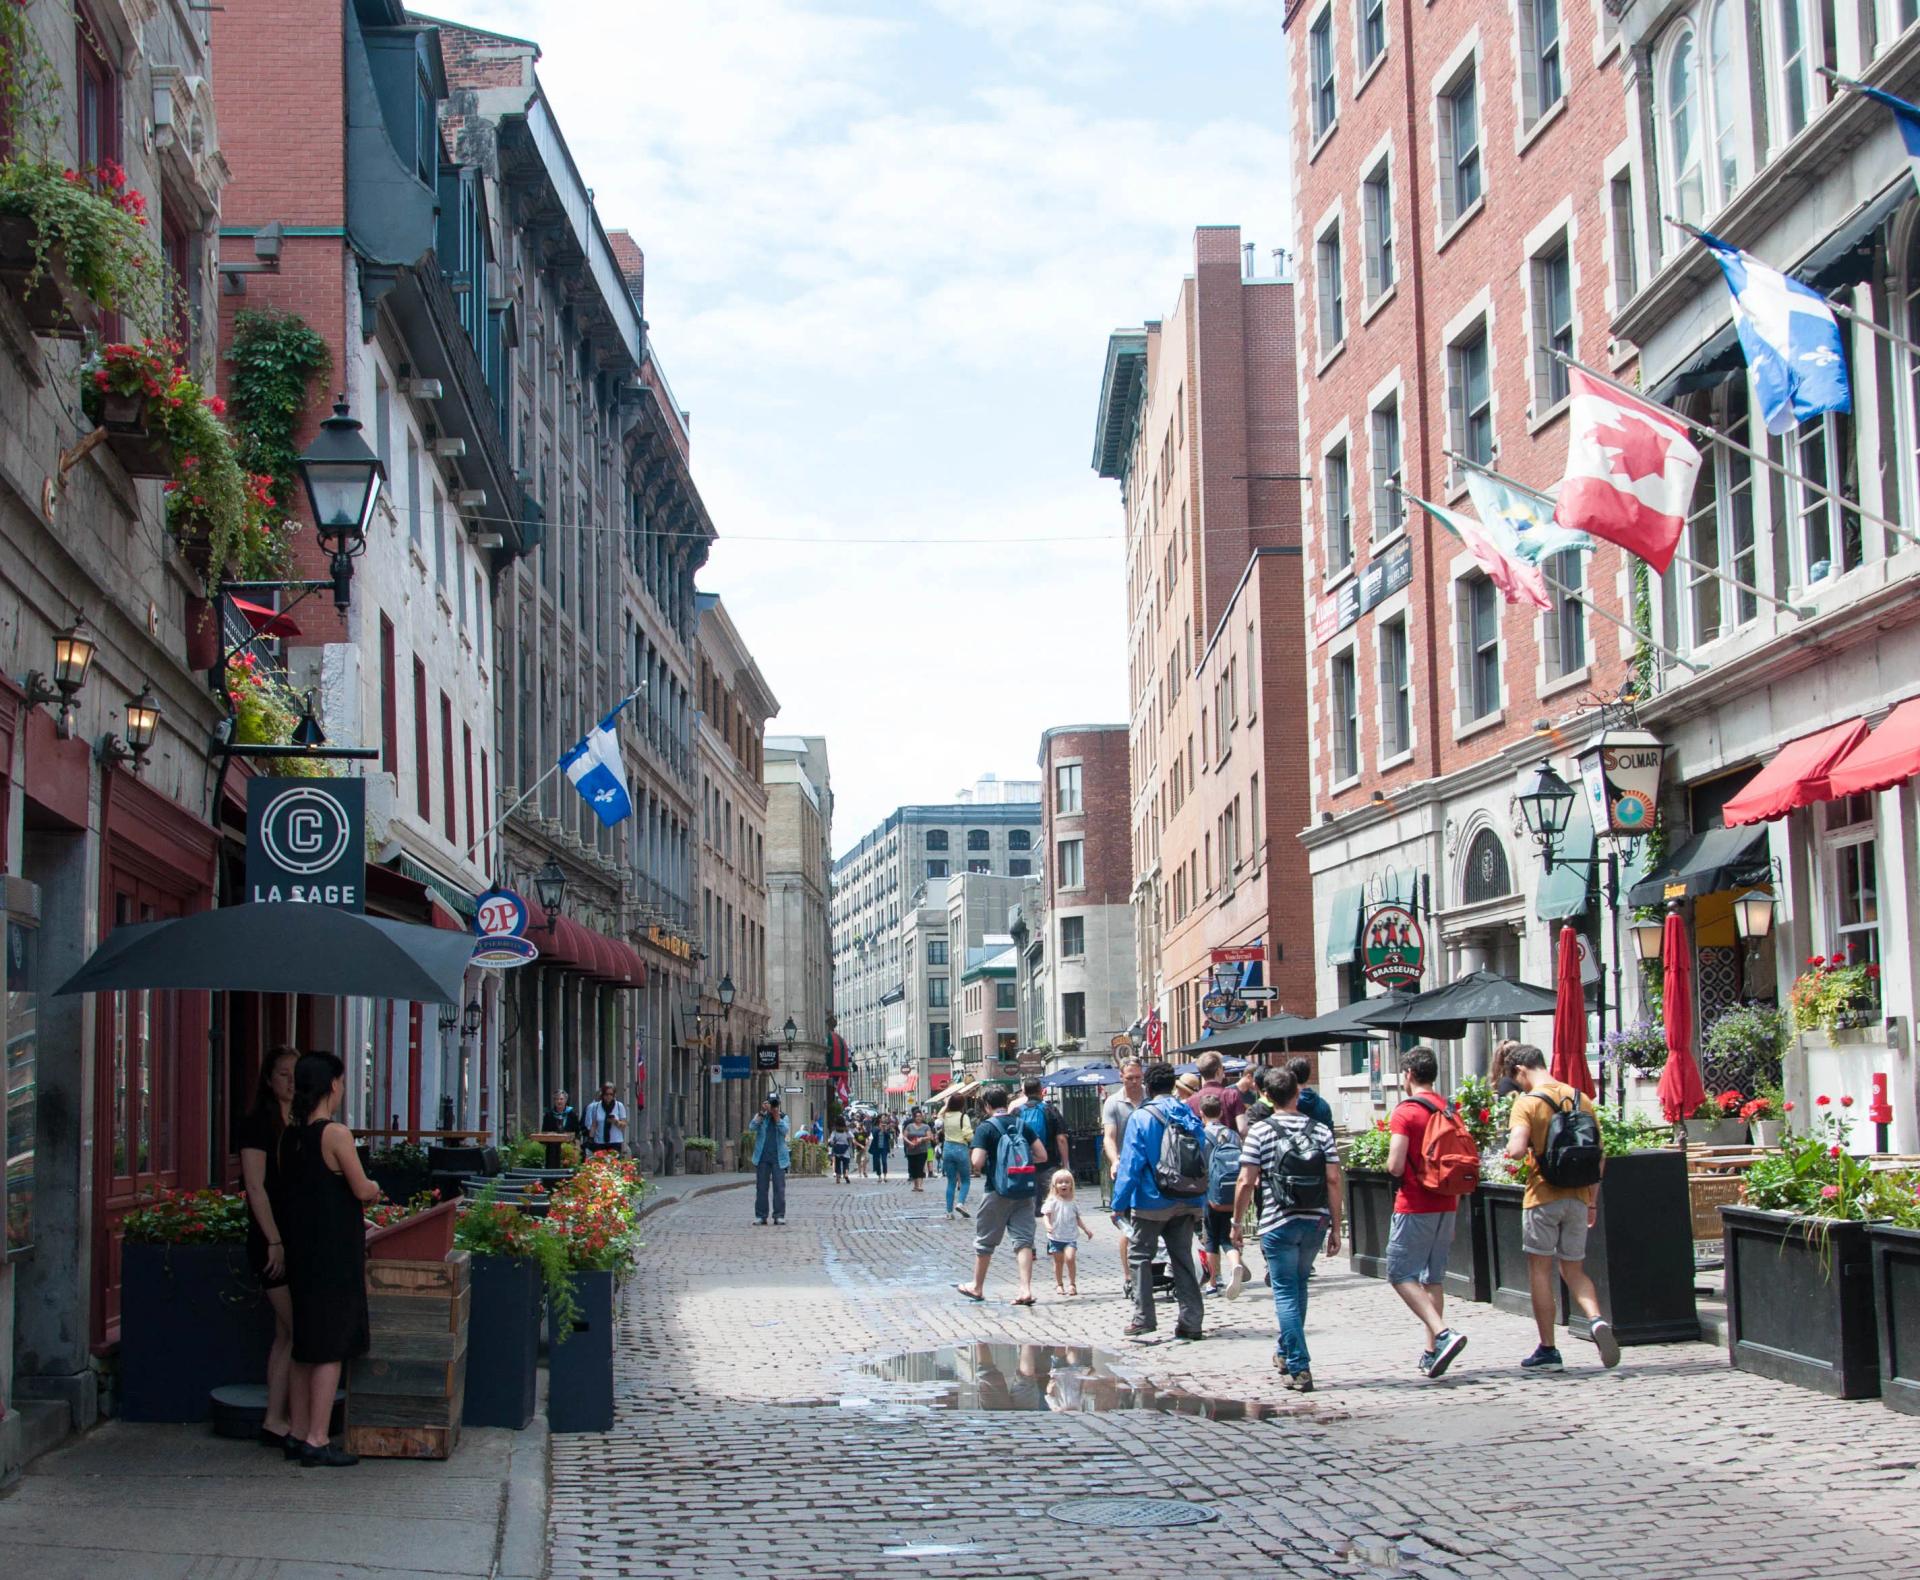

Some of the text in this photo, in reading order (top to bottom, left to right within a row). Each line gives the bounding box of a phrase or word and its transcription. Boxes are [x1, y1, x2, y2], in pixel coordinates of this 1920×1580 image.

[1603, 748, 1658, 771] SOLMAR
[254, 885, 282, 903] LA
[480, 902, 519, 933] 2P
[1392, 955, 1399, 963] 3
[1372, 965, 1420, 978] BRASSEURS
